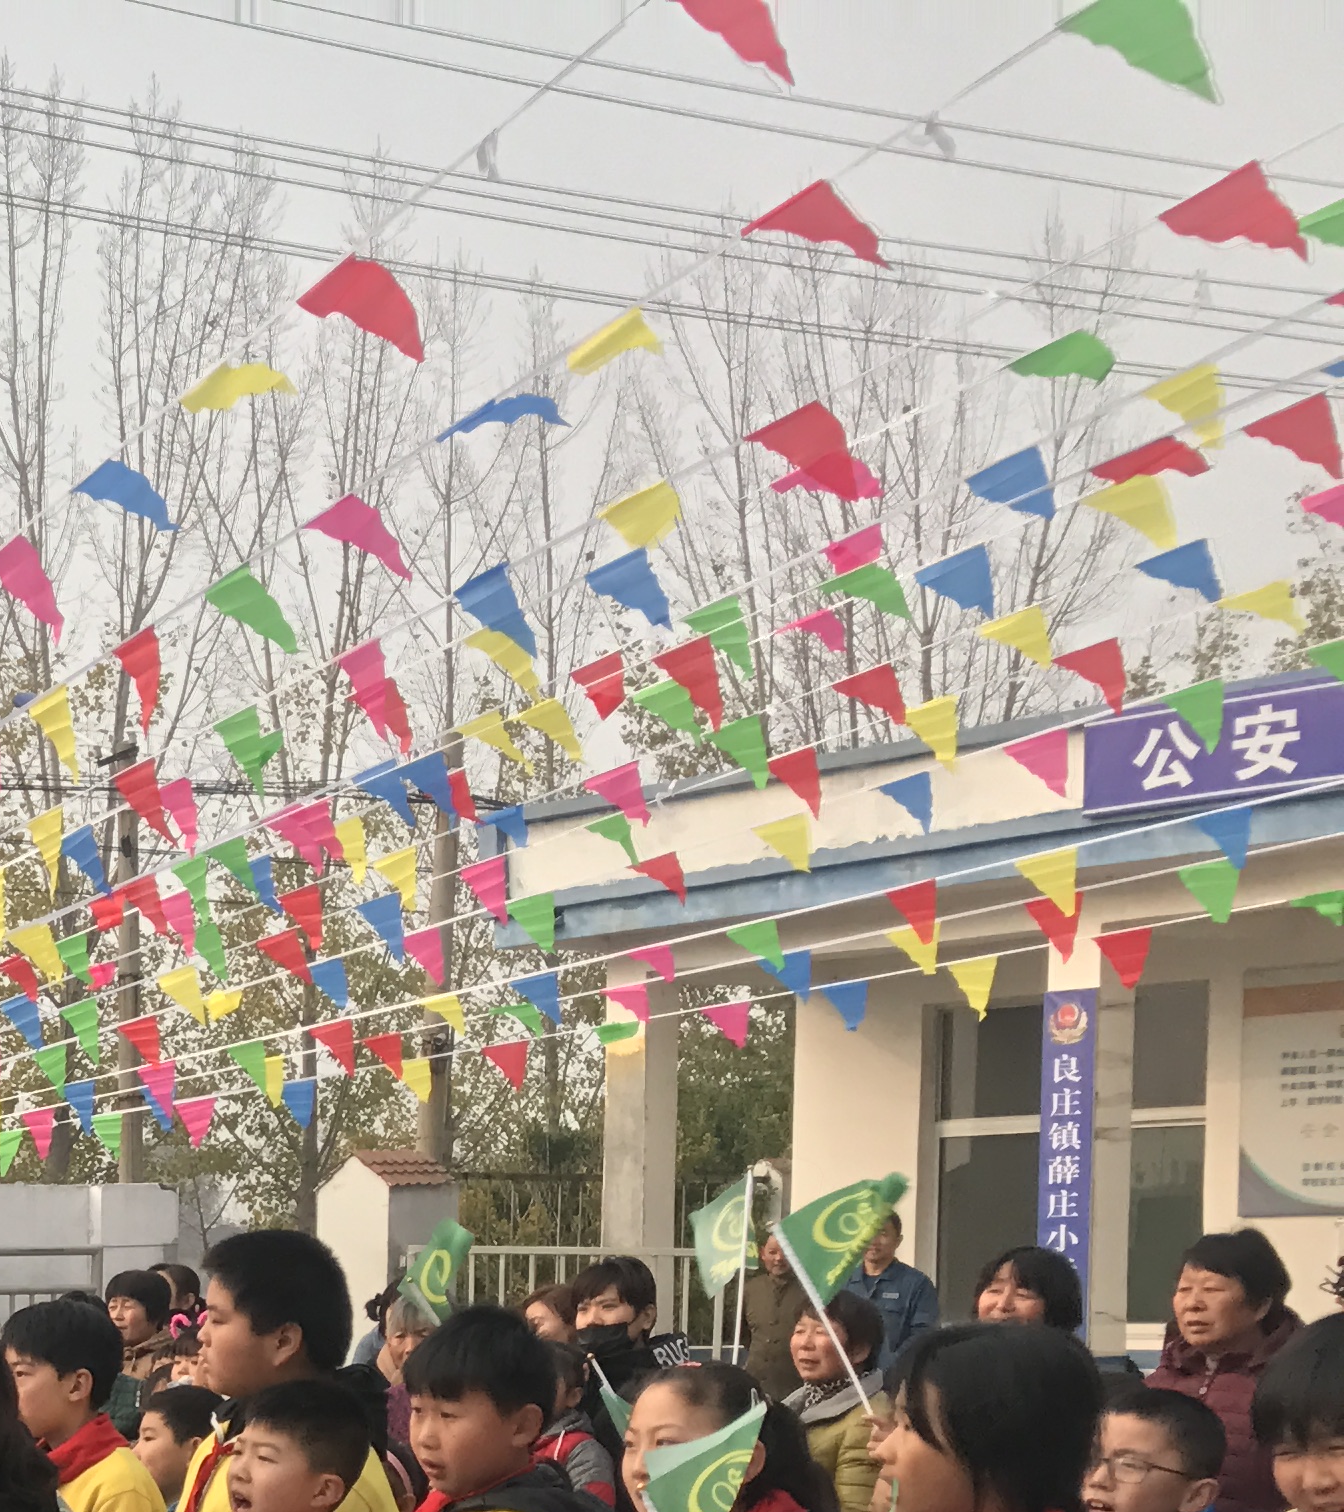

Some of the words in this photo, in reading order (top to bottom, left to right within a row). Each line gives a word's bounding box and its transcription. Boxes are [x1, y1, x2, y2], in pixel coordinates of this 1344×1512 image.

[1132, 703, 1301, 791] 公安
[1045, 1053, 1083, 1269] 良庄镇薛庄小
